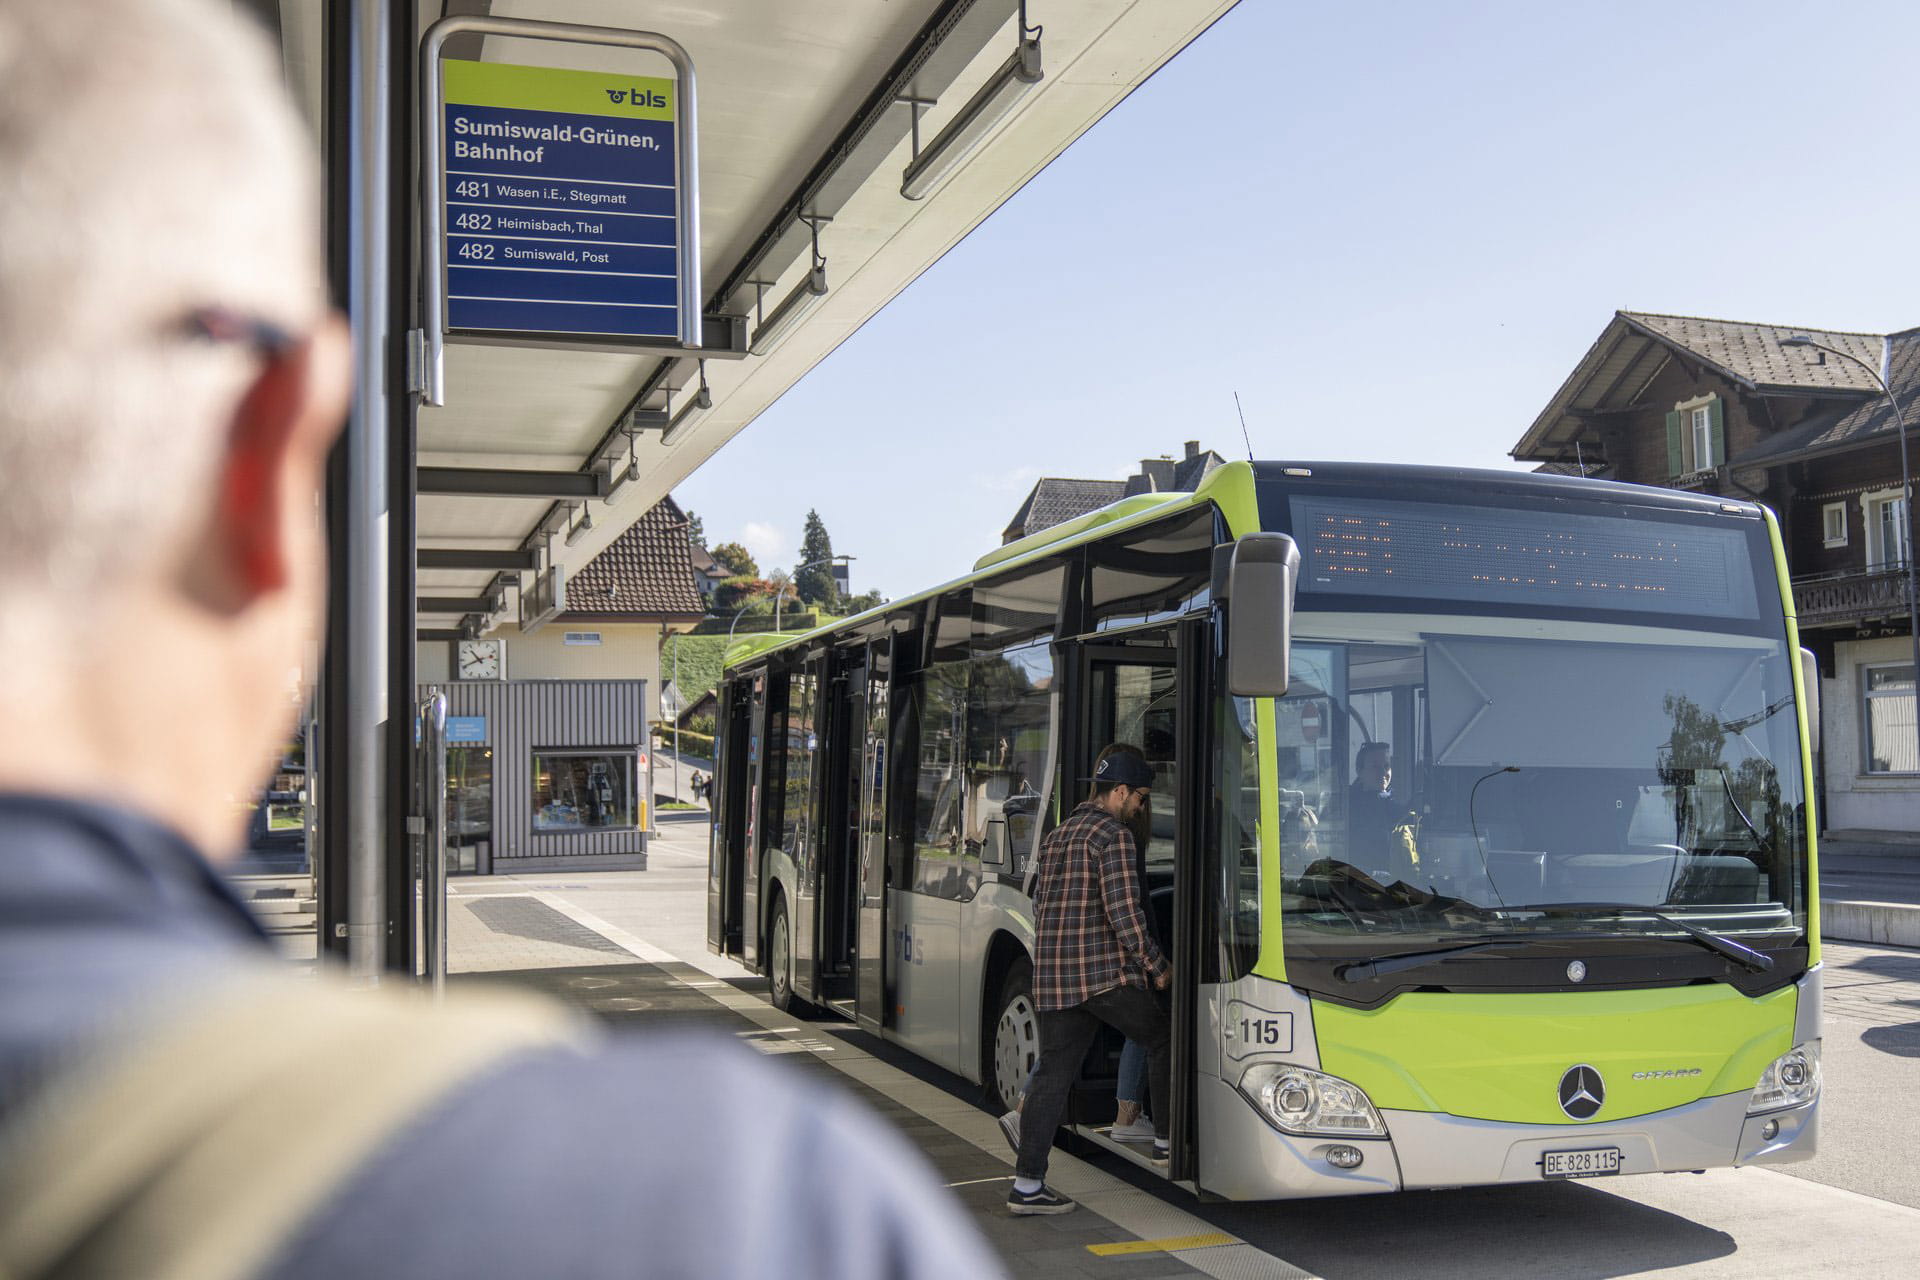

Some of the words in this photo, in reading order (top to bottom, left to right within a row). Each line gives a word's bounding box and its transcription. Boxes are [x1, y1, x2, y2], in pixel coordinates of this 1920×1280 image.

[630, 88, 666, 108] bls
[454, 117, 660, 151] Sumiswald-Grünen,
[454, 140, 544, 163] Bahnhof
[455, 180, 489, 198] 481
[496, 185, 540, 199] Wasen
[543, 187, 567, 202] i.E.,
[569, 189, 627, 205] Stegmatt
[455, 213, 493, 231] 482
[497, 217, 575, 234] Heimisbach,
[575, 221, 603, 234] Thal
[458, 242, 495, 260] 482
[504, 247, 578, 263] Sumiswald,
[582, 251, 609, 263] Post
[1240, 1018, 1279, 1044] 115
